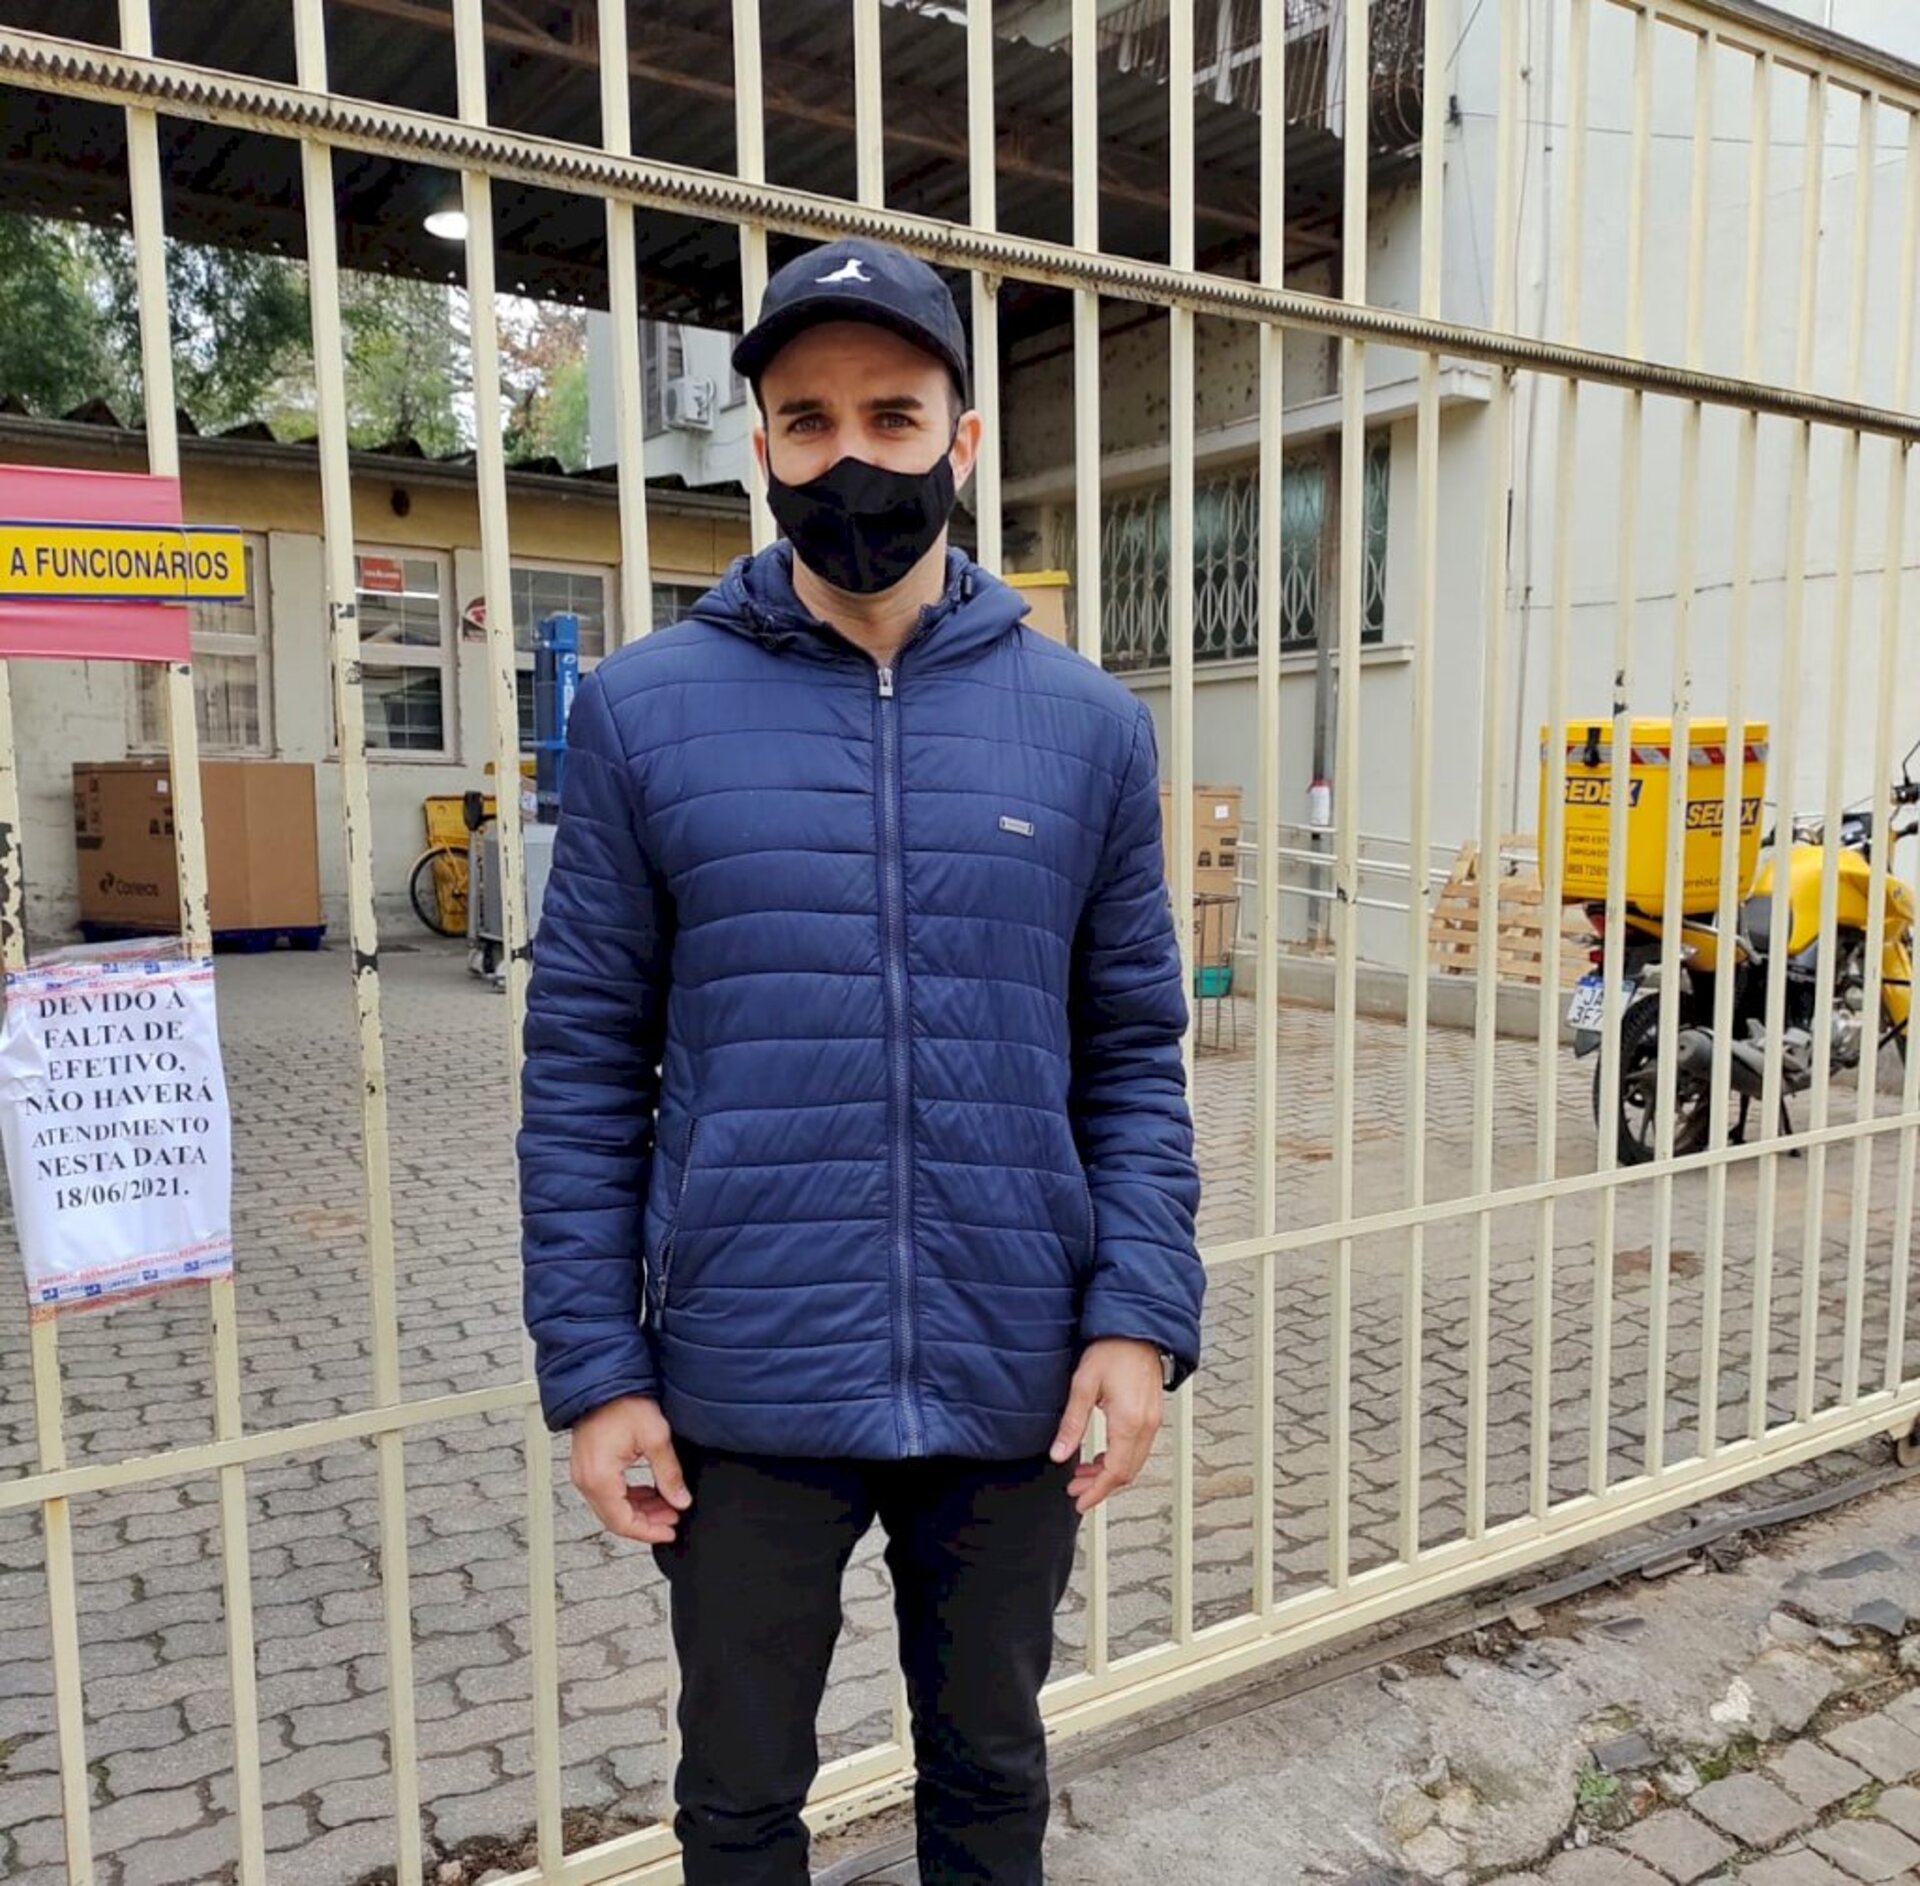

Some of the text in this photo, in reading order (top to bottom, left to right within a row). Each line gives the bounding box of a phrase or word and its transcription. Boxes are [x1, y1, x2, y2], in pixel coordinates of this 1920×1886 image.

[10, 541, 229, 580] A FUNCIONÁRIOS
[1563, 779, 1639, 805] EDE
[1686, 799, 1759, 828] SEDX
[38, 990, 157, 1019] DEVIDO
[44, 1019, 184, 1049] FALTA DE
[48, 1051, 187, 1081] EFETIVO,
[26, 1076, 214, 1117] NÃO HAVERÁ
[32, 1116, 210, 1149] ATENDIMENTO
[37, 1145, 208, 1181] NESTA DATA
[56, 1176, 190, 1211] 18/06/2021.
